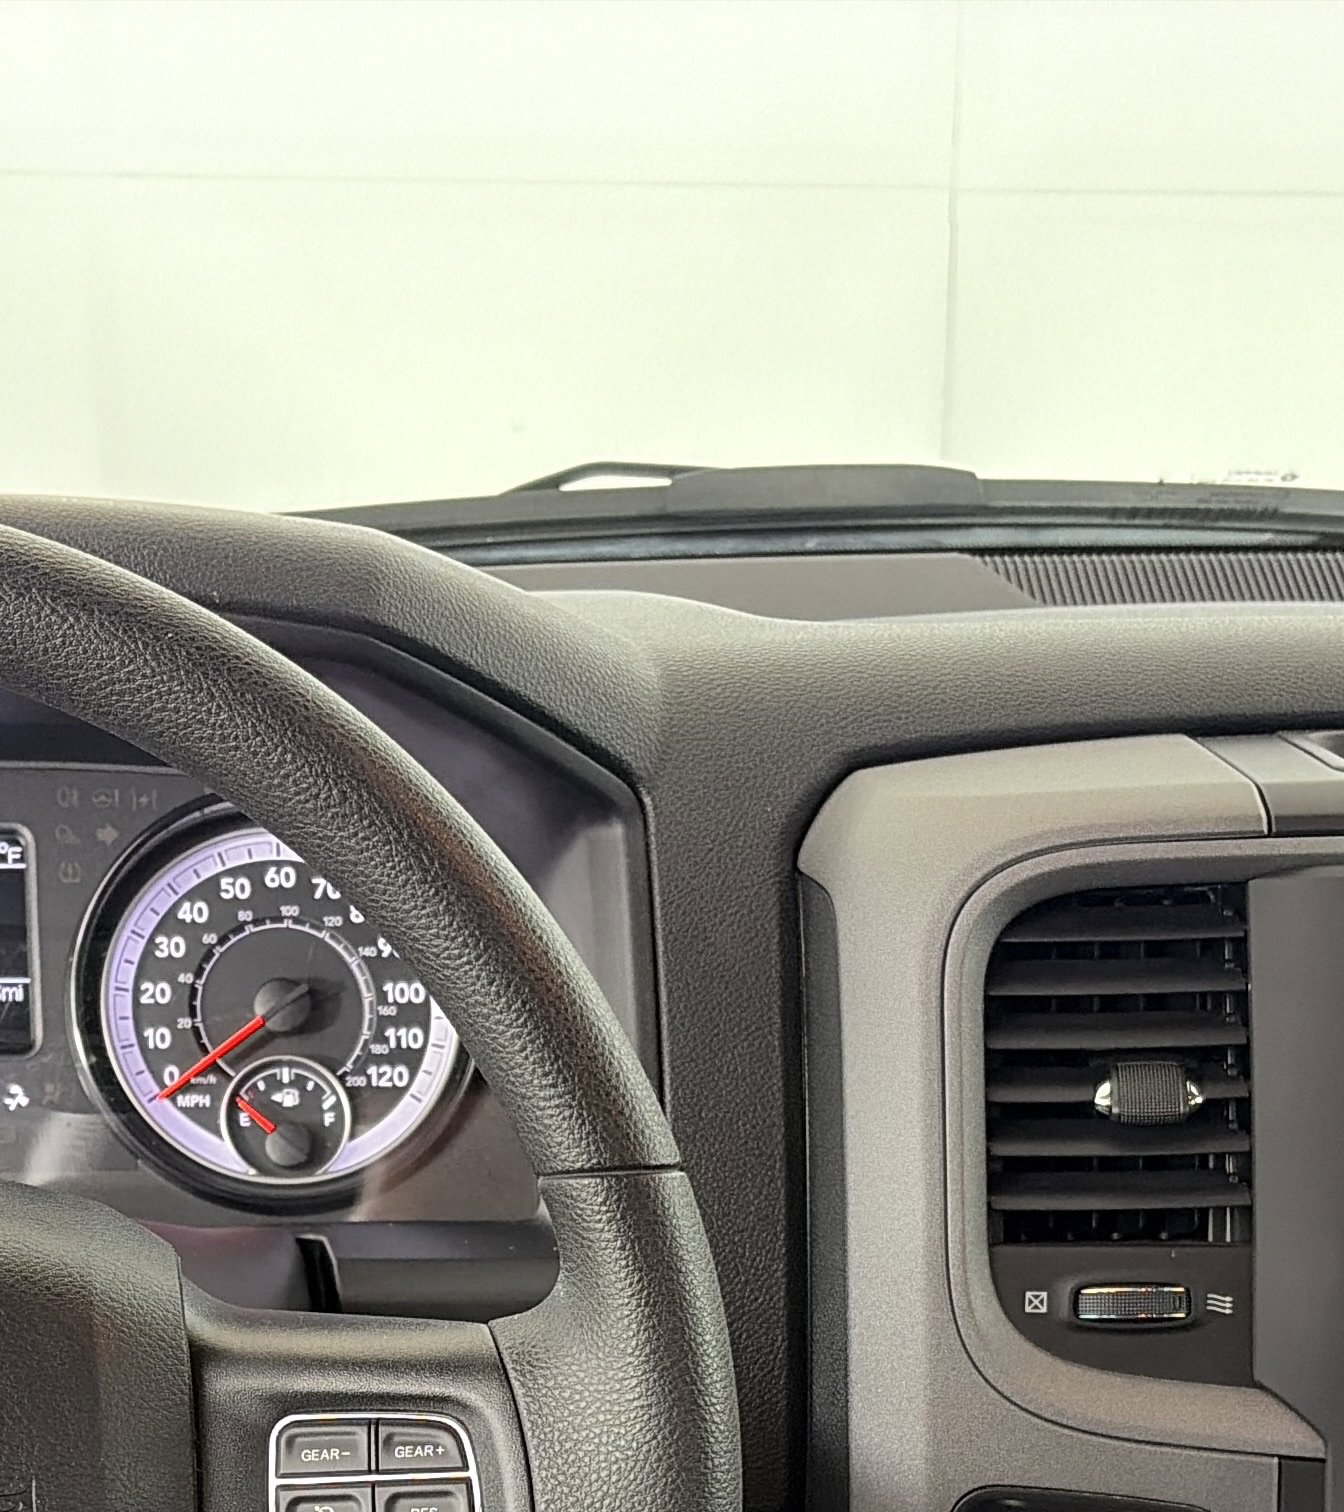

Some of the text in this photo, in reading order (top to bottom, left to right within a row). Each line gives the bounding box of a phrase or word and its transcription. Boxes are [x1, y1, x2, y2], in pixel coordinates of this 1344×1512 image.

[265, 867, 296, 888] 60
[220, 878, 251, 900] 50
[177, 902, 209, 923] 40
[238, 910, 253, 921] 80
[280, 906, 300, 917] 100
[323, 916, 343, 927] 120
[202, 934, 218, 944] 60
[155, 937, 185, 958] 30
[358, 946, 377, 957] 140
[178, 973, 193, 984] 40
[140, 983, 171, 1004] 20
[383, 982, 426, 1004] 100
[377, 1005, 397, 1016] 160
[177, 1018, 192, 1028] 20
[144, 1028, 171, 1049] 10
[384, 1028, 424, 1049] 110
[369, 1044, 389, 1054] 180
[163, 1065, 180, 1085] 0
[345, 1076, 367, 1087] 200
[366, 1065, 409, 1087] 120
[177, 1094, 211, 1108] MPH
[239, 1113, 251, 1127] E
[324, 1112, 335, 1127] F
